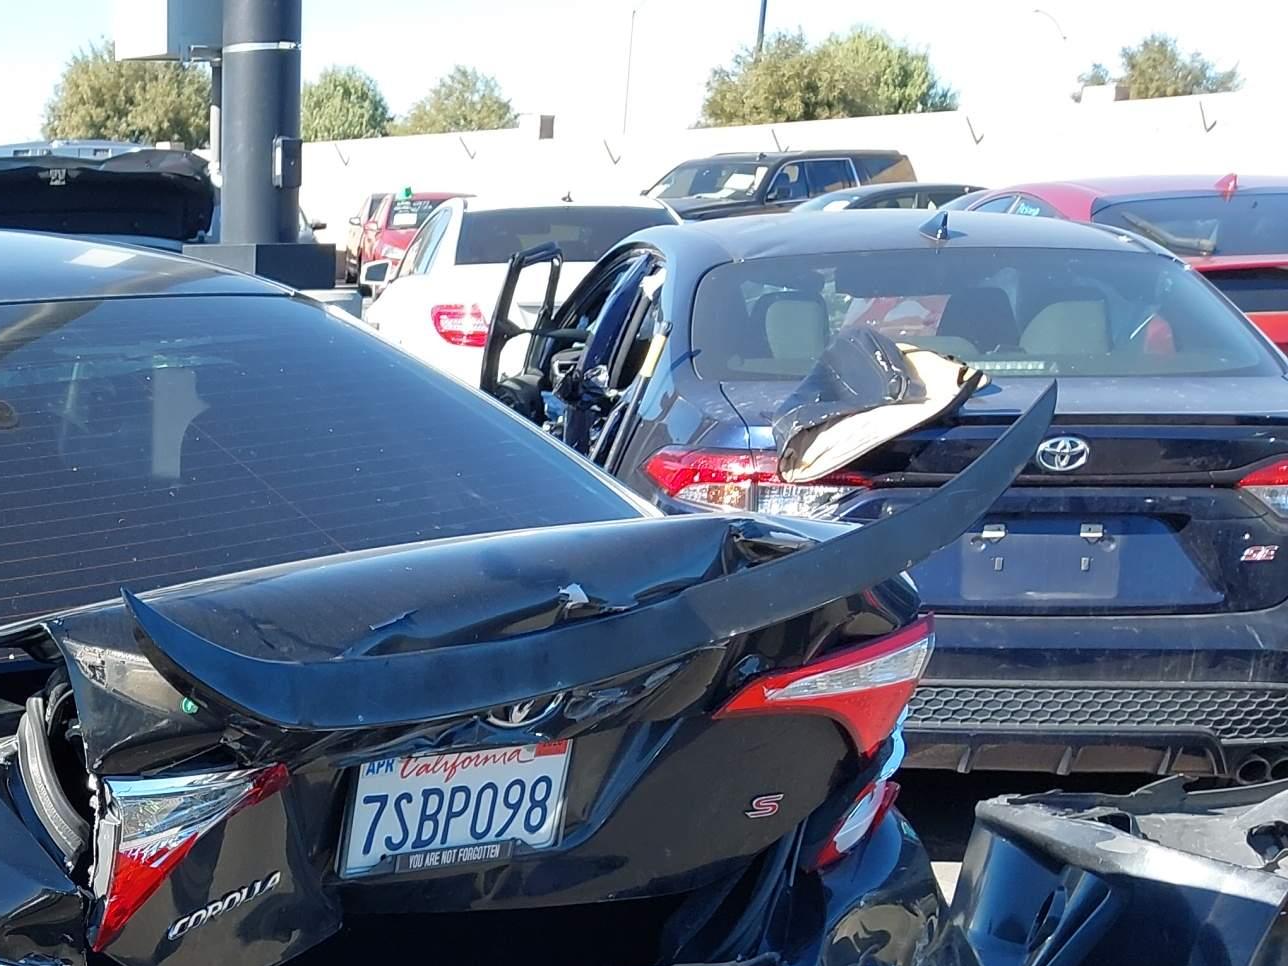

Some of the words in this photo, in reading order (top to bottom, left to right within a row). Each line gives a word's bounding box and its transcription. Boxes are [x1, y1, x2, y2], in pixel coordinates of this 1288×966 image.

[400, 747, 535, 783] California
[362, 775, 553, 855] 7SBP098
[745, 794, 784, 818] S
[409, 853, 424, 869] YOU
[424, 851, 441, 867] ARE
[441, 848, 457, 865] NOT
[457, 844, 501, 862] FORGOTTEN
[168, 871, 281, 941] COROLLA
